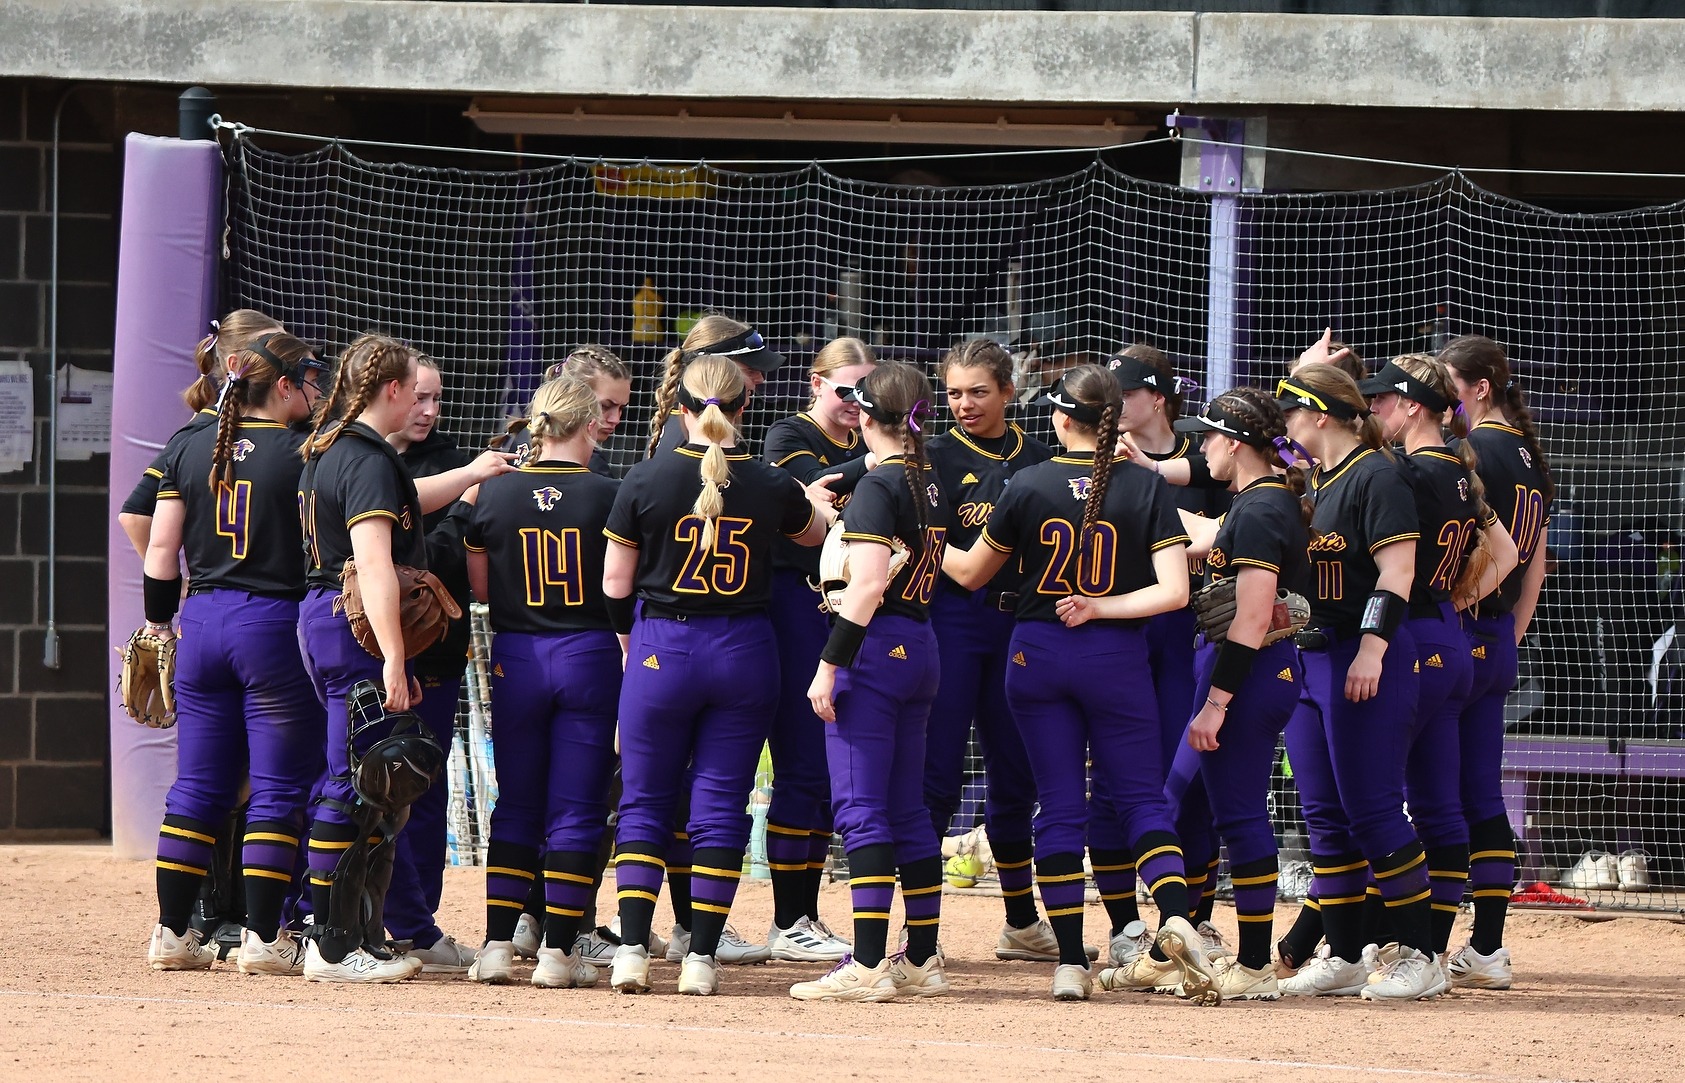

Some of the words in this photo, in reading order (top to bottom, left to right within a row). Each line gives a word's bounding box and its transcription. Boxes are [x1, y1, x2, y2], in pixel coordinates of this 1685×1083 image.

[216, 480, 252, 560] 4
[671, 514, 753, 595] 25
[1036, 517, 1118, 597] 20
[1509, 484, 1544, 564] 10
[518, 527, 584, 606] 14
[1316, 560, 1343, 600] 11
